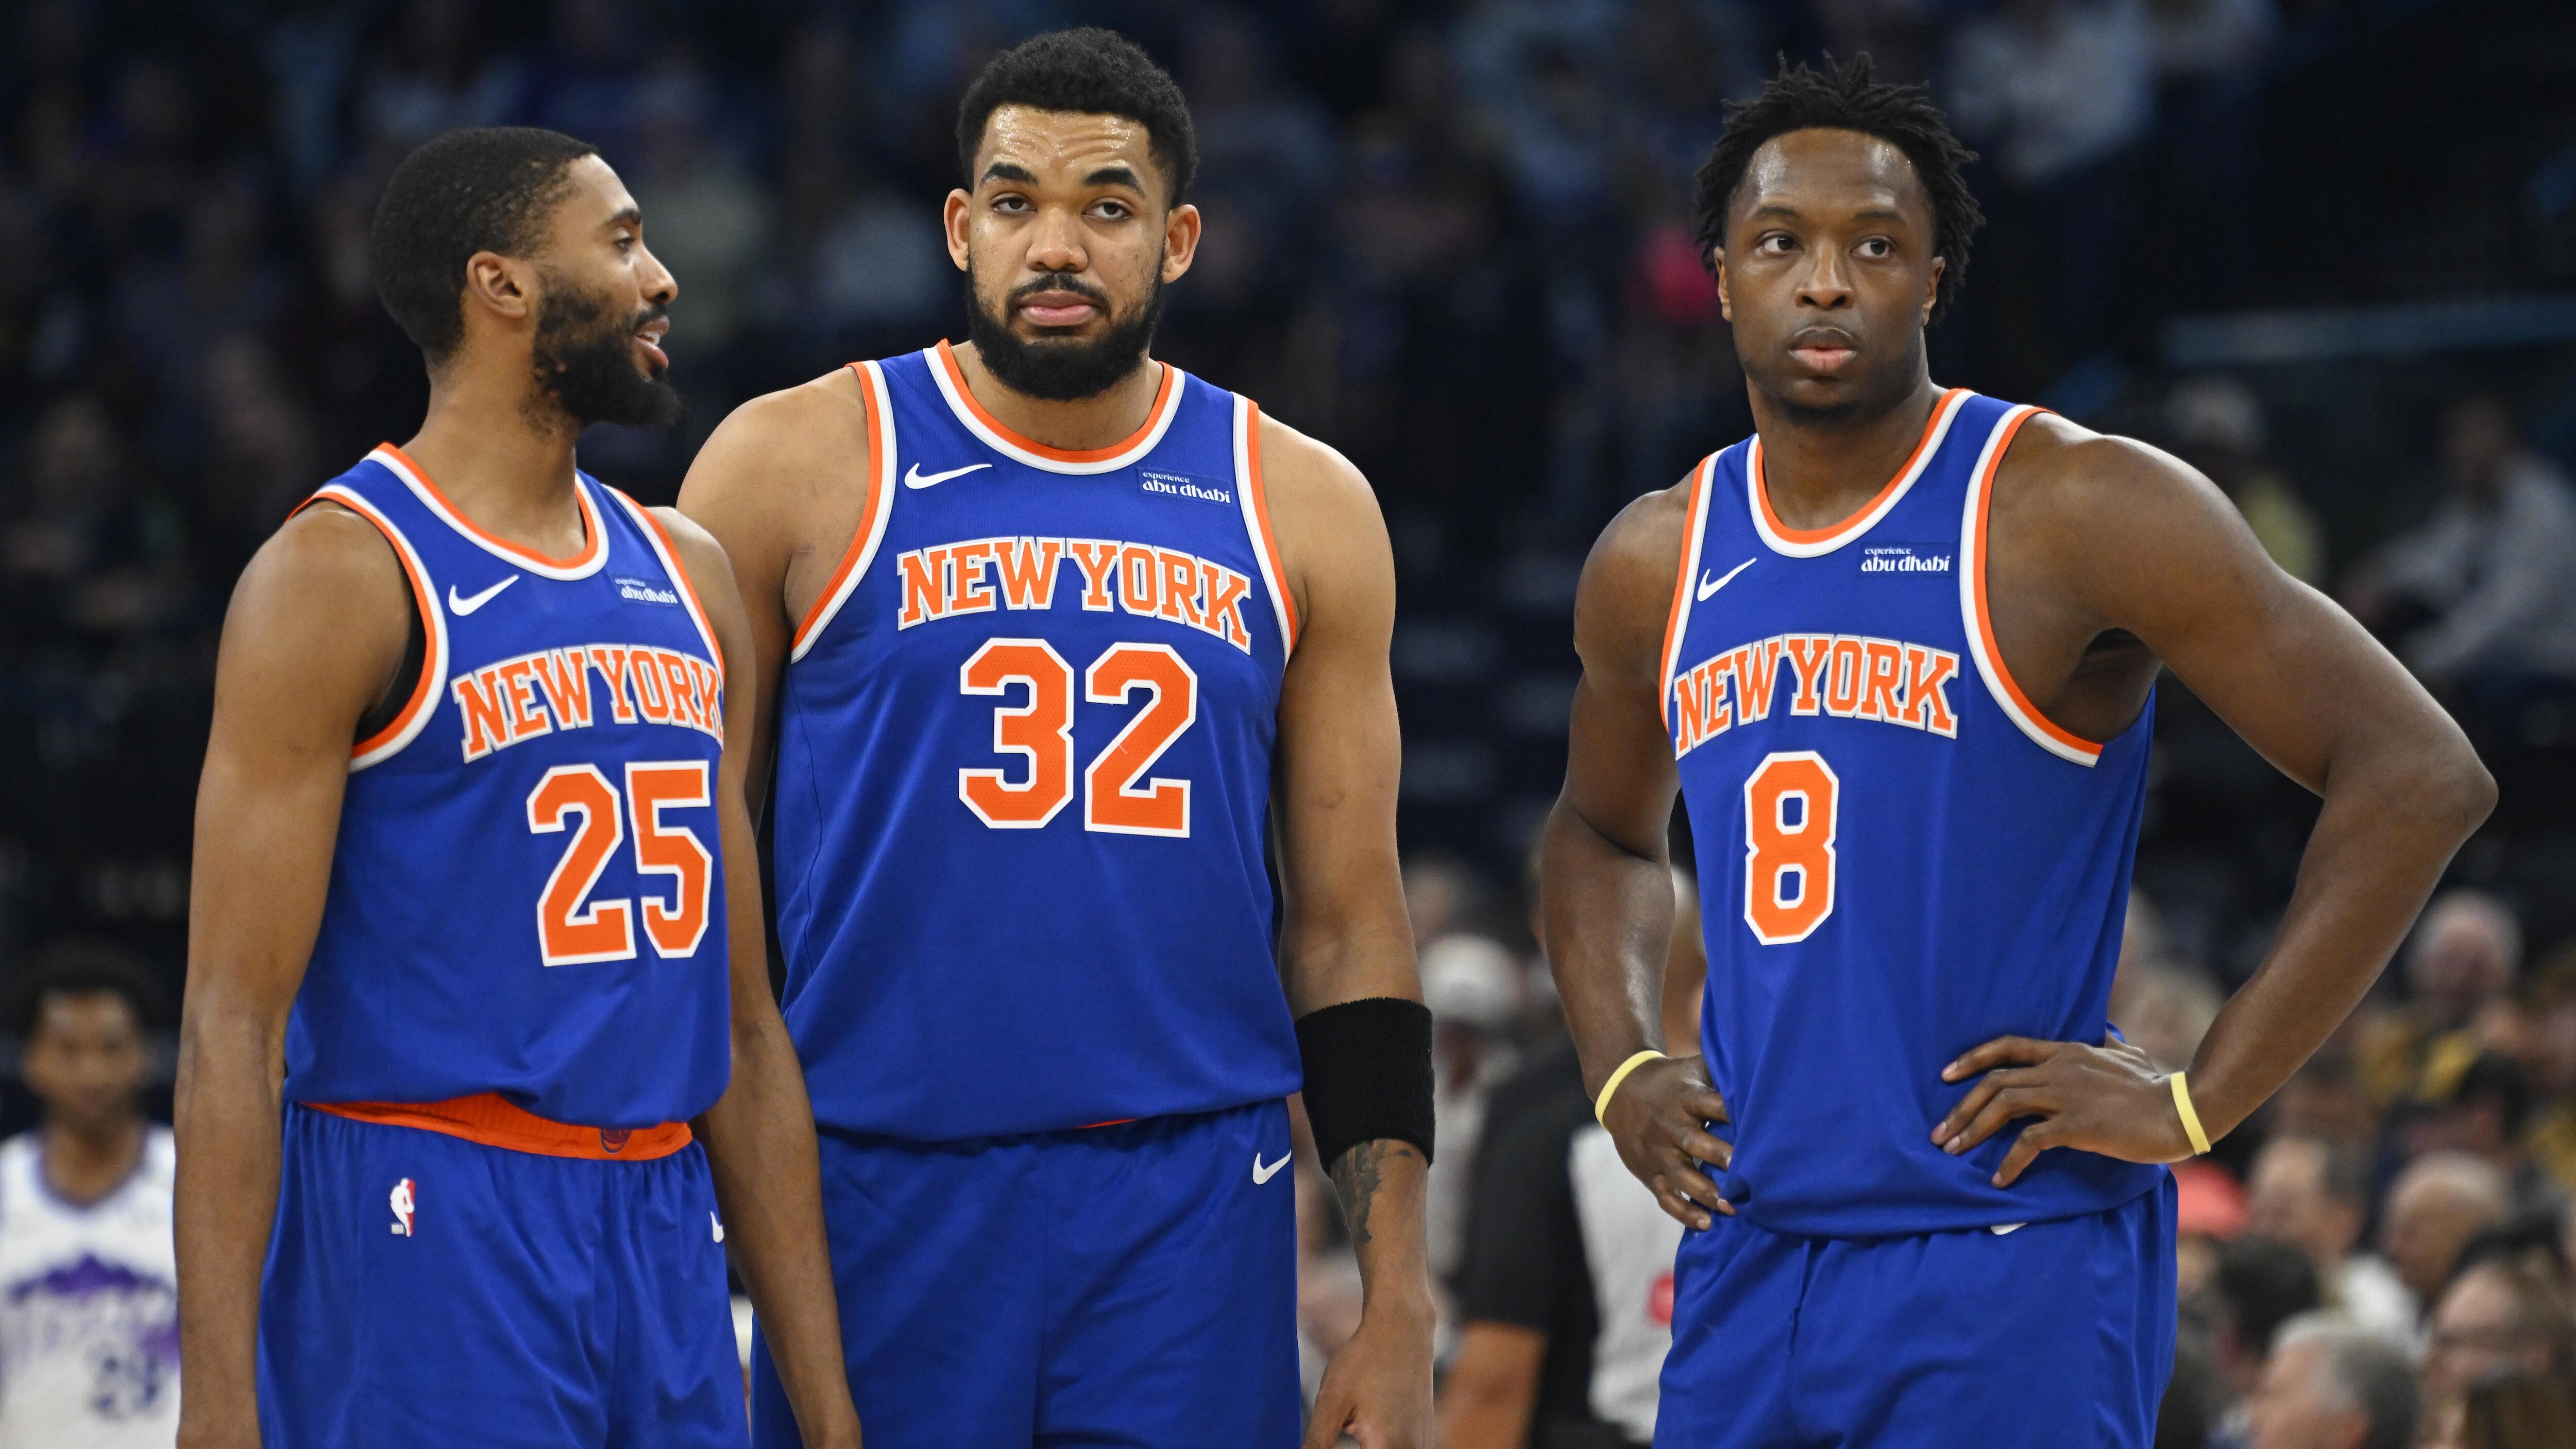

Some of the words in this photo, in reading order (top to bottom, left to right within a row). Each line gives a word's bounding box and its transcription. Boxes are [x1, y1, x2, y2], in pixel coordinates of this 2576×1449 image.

[1142, 479, 1177, 495] abu
[1179, 484, 1230, 503] dhabi
[1143, 471, 1190, 483] experience
[1861, 555, 1896, 572] abu
[1897, 554, 1951, 572] dhabi
[1864, 547, 1911, 556] experience
[621, 585, 645, 601] abu
[643, 587, 679, 604] dhabi
[897, 536, 1066, 631] NEW
[1066, 537, 1251, 655] YORK
[450, 645, 593, 764] NEW
[585, 643, 724, 751] YORK
[1673, 635, 1785, 761] NEW
[1783, 634, 1959, 740] YORK
[959, 638, 1197, 838] 32
[527, 760, 713, 967] 25
[1744, 751, 1839, 946] 8
[391, 1222, 404, 1235] NBA
